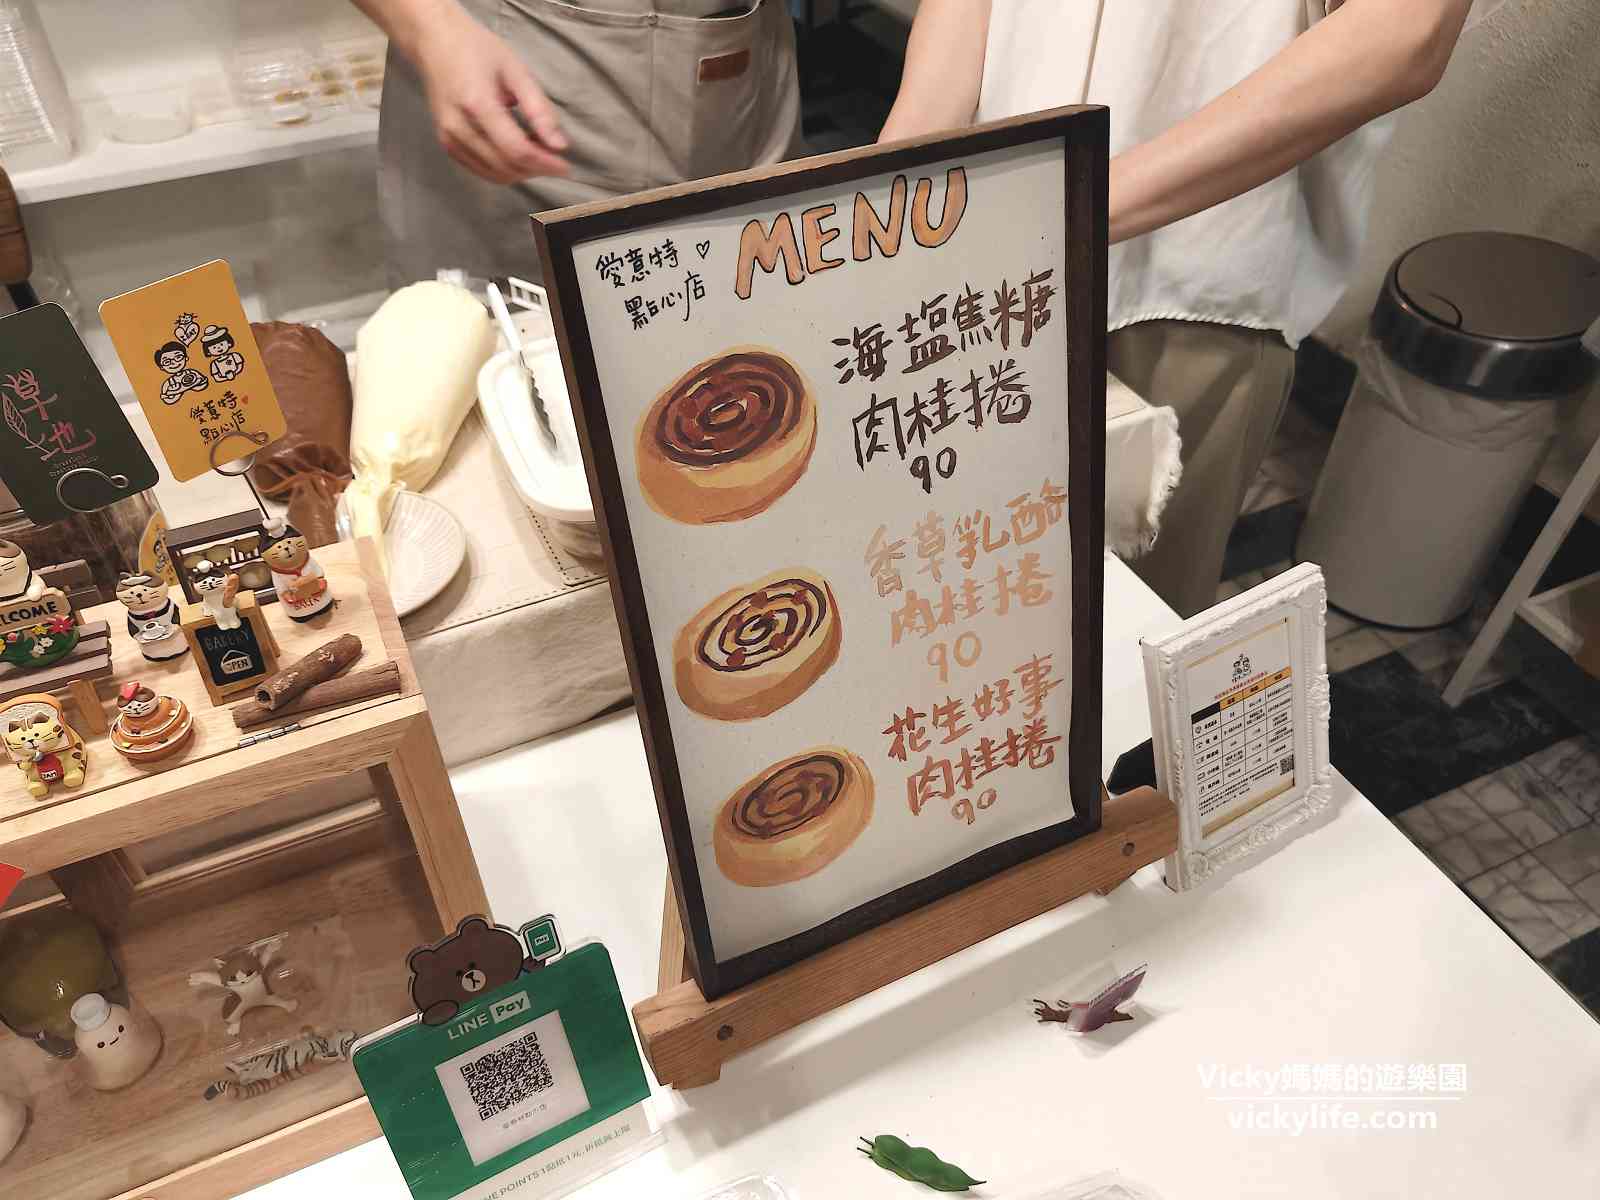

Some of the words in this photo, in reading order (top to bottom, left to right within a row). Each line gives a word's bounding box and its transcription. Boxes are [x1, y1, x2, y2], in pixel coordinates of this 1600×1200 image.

[735, 166, 967, 300] MENU
[624, 270, 706, 330] 點心店
[851, 359, 1032, 471] 肉桂捲
[910, 446, 957, 494] 90
[864, 478, 1067, 597] 香草乳酪
[0, 601, 59, 625] LCOME
[891, 552, 1054, 648] 肉桂捲
[926, 630, 983, 683] 90
[881, 653, 1064, 761] 花生好事
[907, 718, 1062, 816] 肉桂捲
[951, 787, 998, 824] 90
[447, 1011, 489, 1040] LINE
[495, 997, 524, 1017] Pay
[500, 1171, 541, 1198] POINTS
